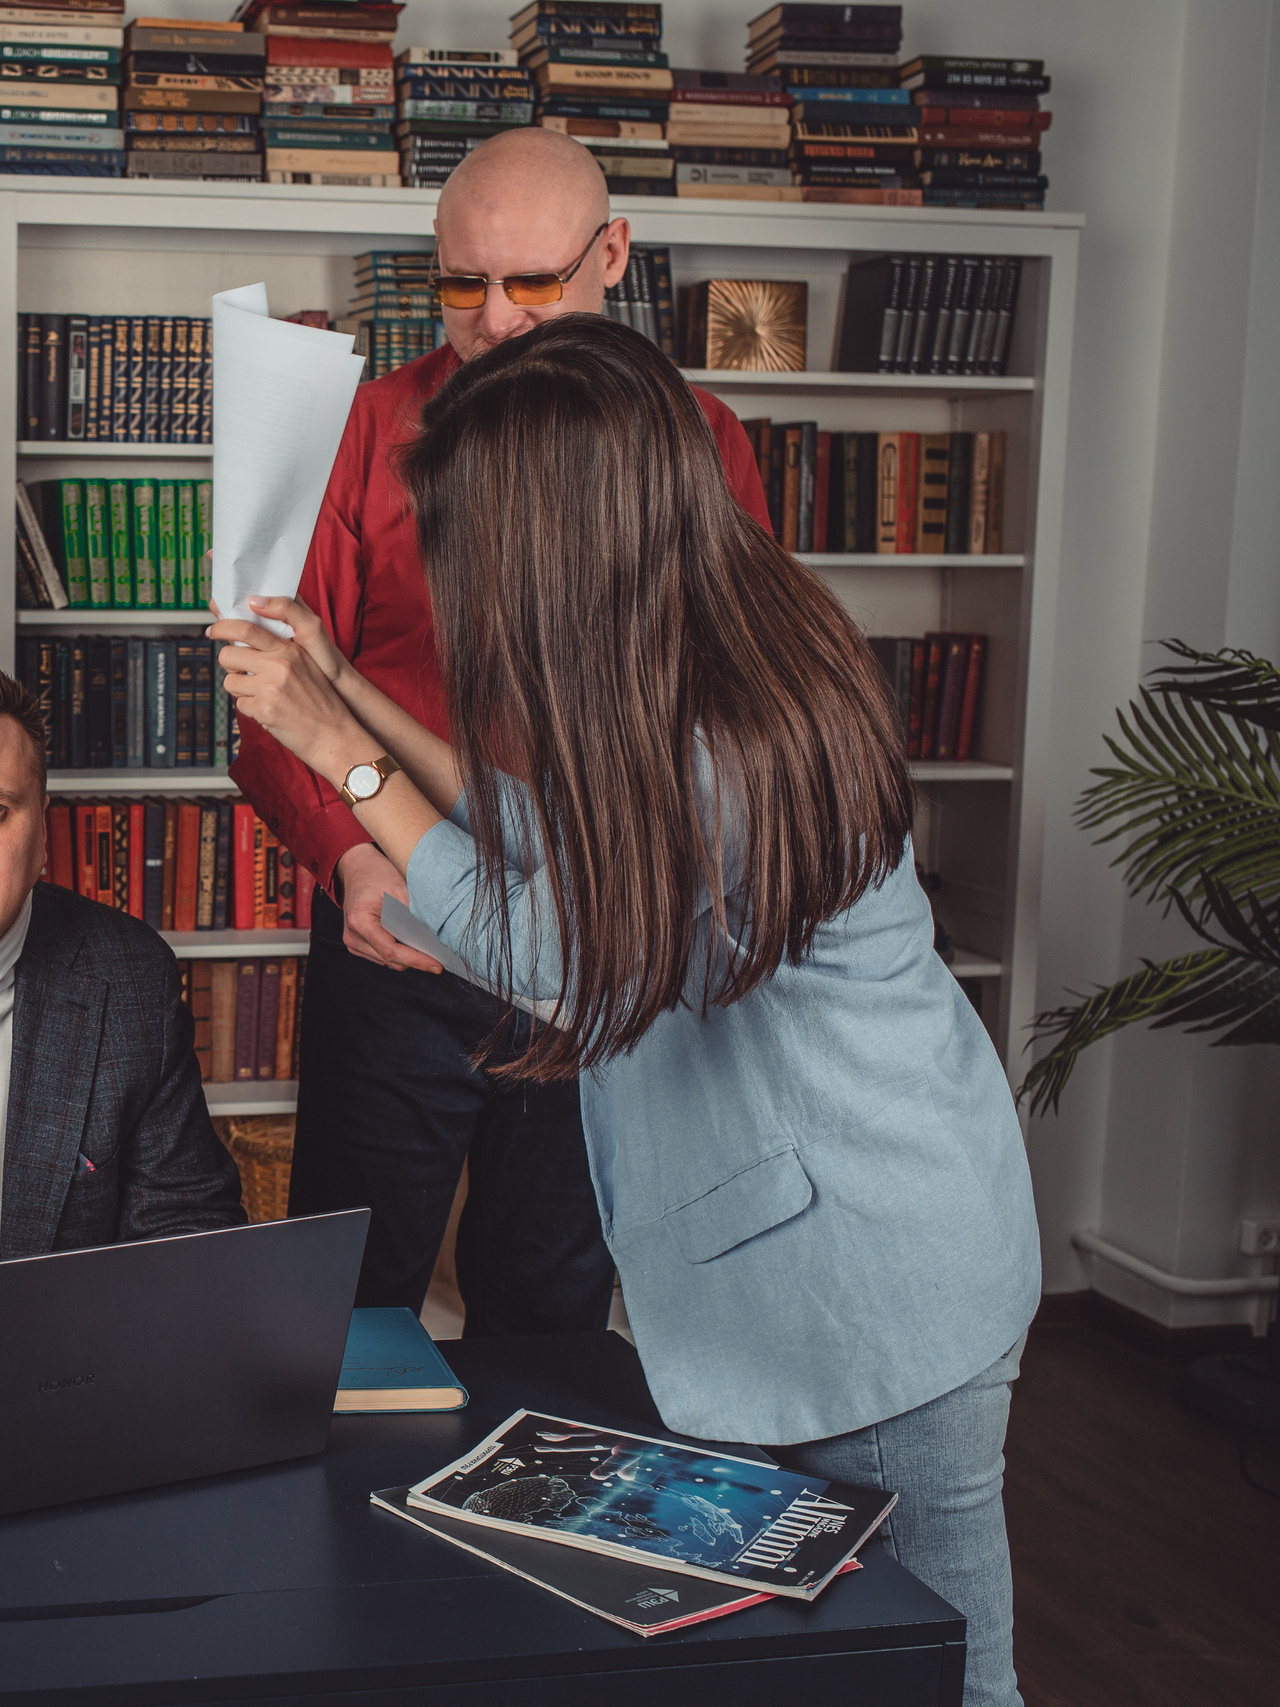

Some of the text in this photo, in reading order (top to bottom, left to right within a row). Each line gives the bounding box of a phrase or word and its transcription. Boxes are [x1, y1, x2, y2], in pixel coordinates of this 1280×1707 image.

[37, 1374, 95, 1392] HONOR
[736, 1487, 855, 1573] Alumni
[808, 1517, 831, 1538] MAGAZINE
[823, 1519, 846, 1534] NES
[637, 1596, 670, 1609] РЭШ
